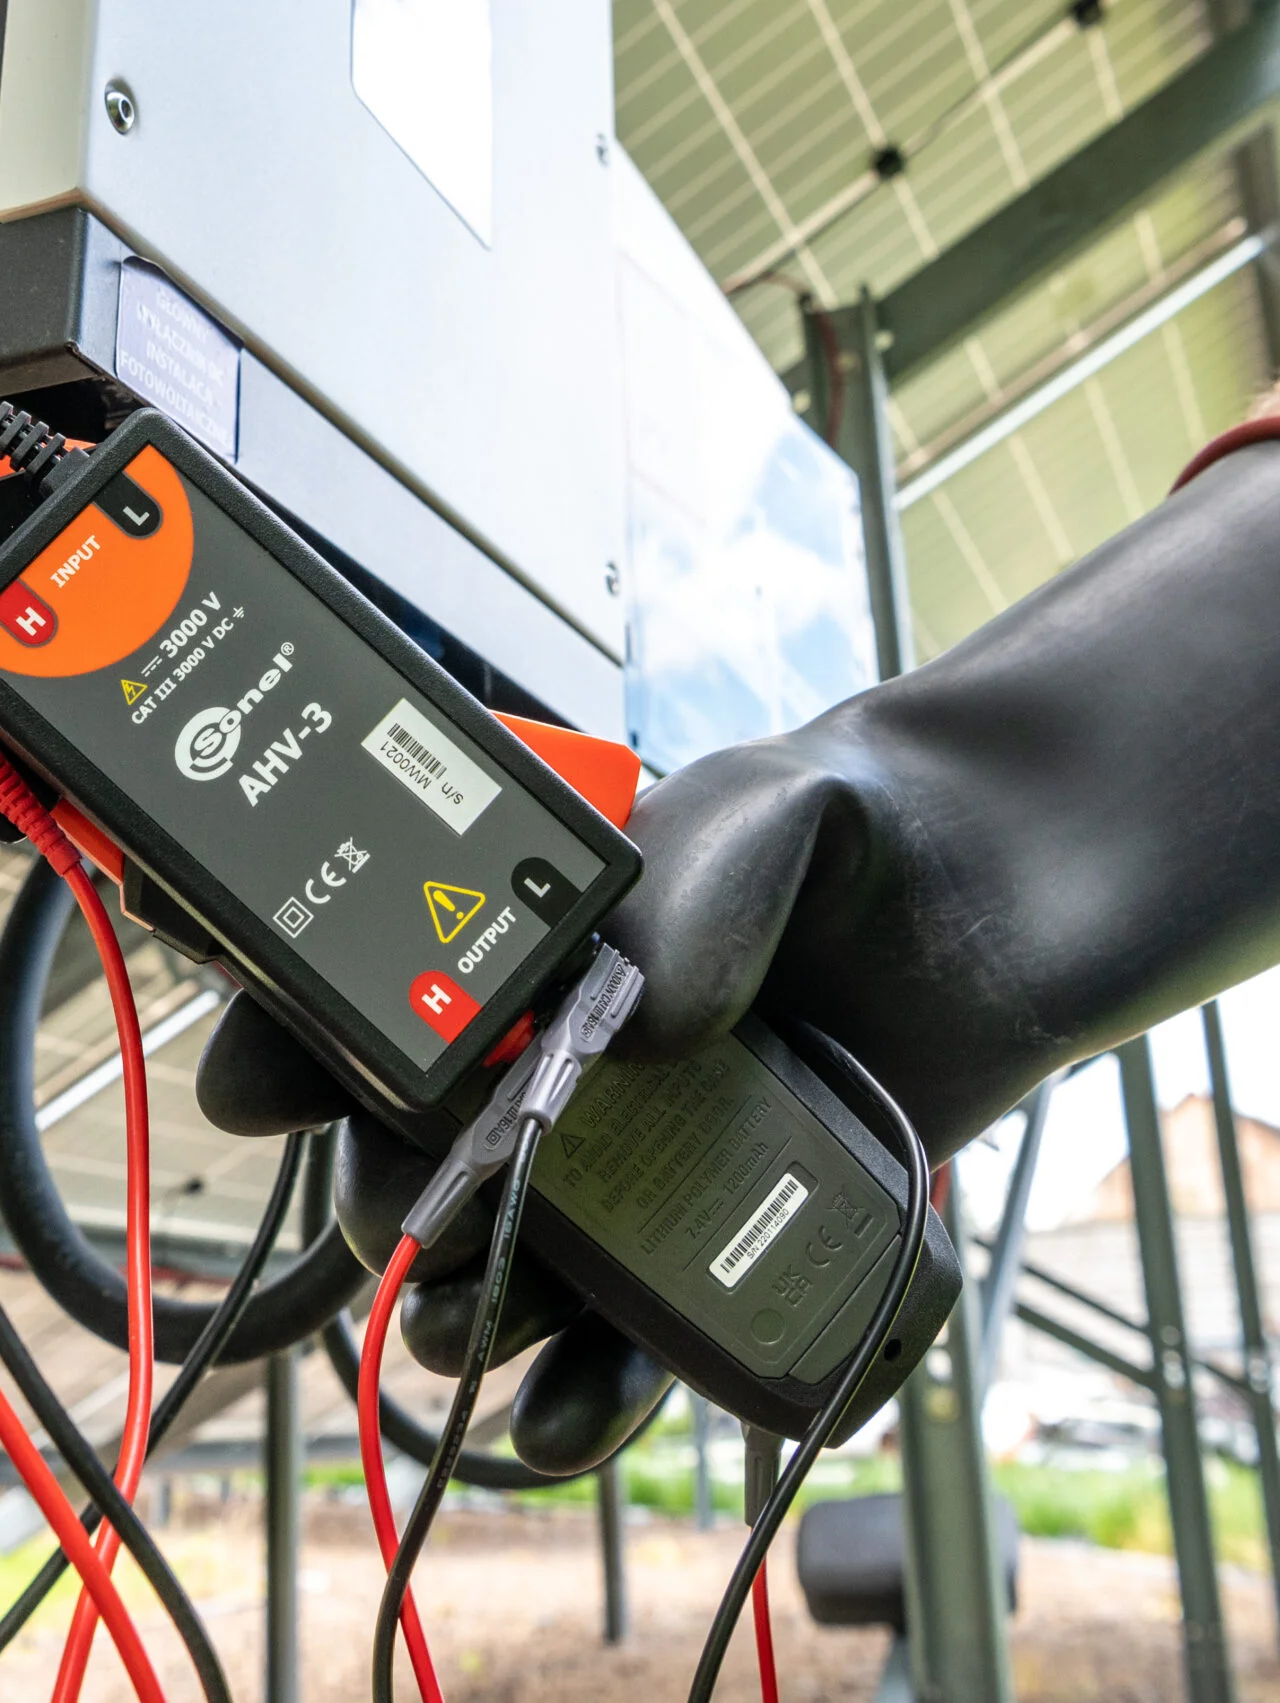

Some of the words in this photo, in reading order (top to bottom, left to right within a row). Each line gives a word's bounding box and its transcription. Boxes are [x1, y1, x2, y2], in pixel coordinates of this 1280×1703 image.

[122, 505, 150, 527] L
[49, 534, 101, 589] INPUT
[15, 606, 47, 637] H
[159, 608, 208, 659] 3000
[201, 591, 221, 611] V
[131, 696, 158, 725] CAT
[154, 677, 177, 701] III
[172, 647, 206, 682] 3000
[201, 635, 215, 649] V
[212, 617, 234, 640] DC
[238, 702, 333, 808] AHV-3
[381, 741, 432, 789] MW0021
[441, 780, 464, 805] s/n
[523, 876, 551, 899] L
[457, 906, 517, 974] OUTPUT
[421, 983, 452, 1014] H
[580, 1061, 646, 1129] WARNIN
[640, 1205, 688, 1255] LITHIUM
[683, 1149, 734, 1208] POLYMER
[725, 1096, 773, 1150] BATTERY
[721, 1142, 769, 1195] 1200mAh
[758, 1208, 790, 1247] 220114090
